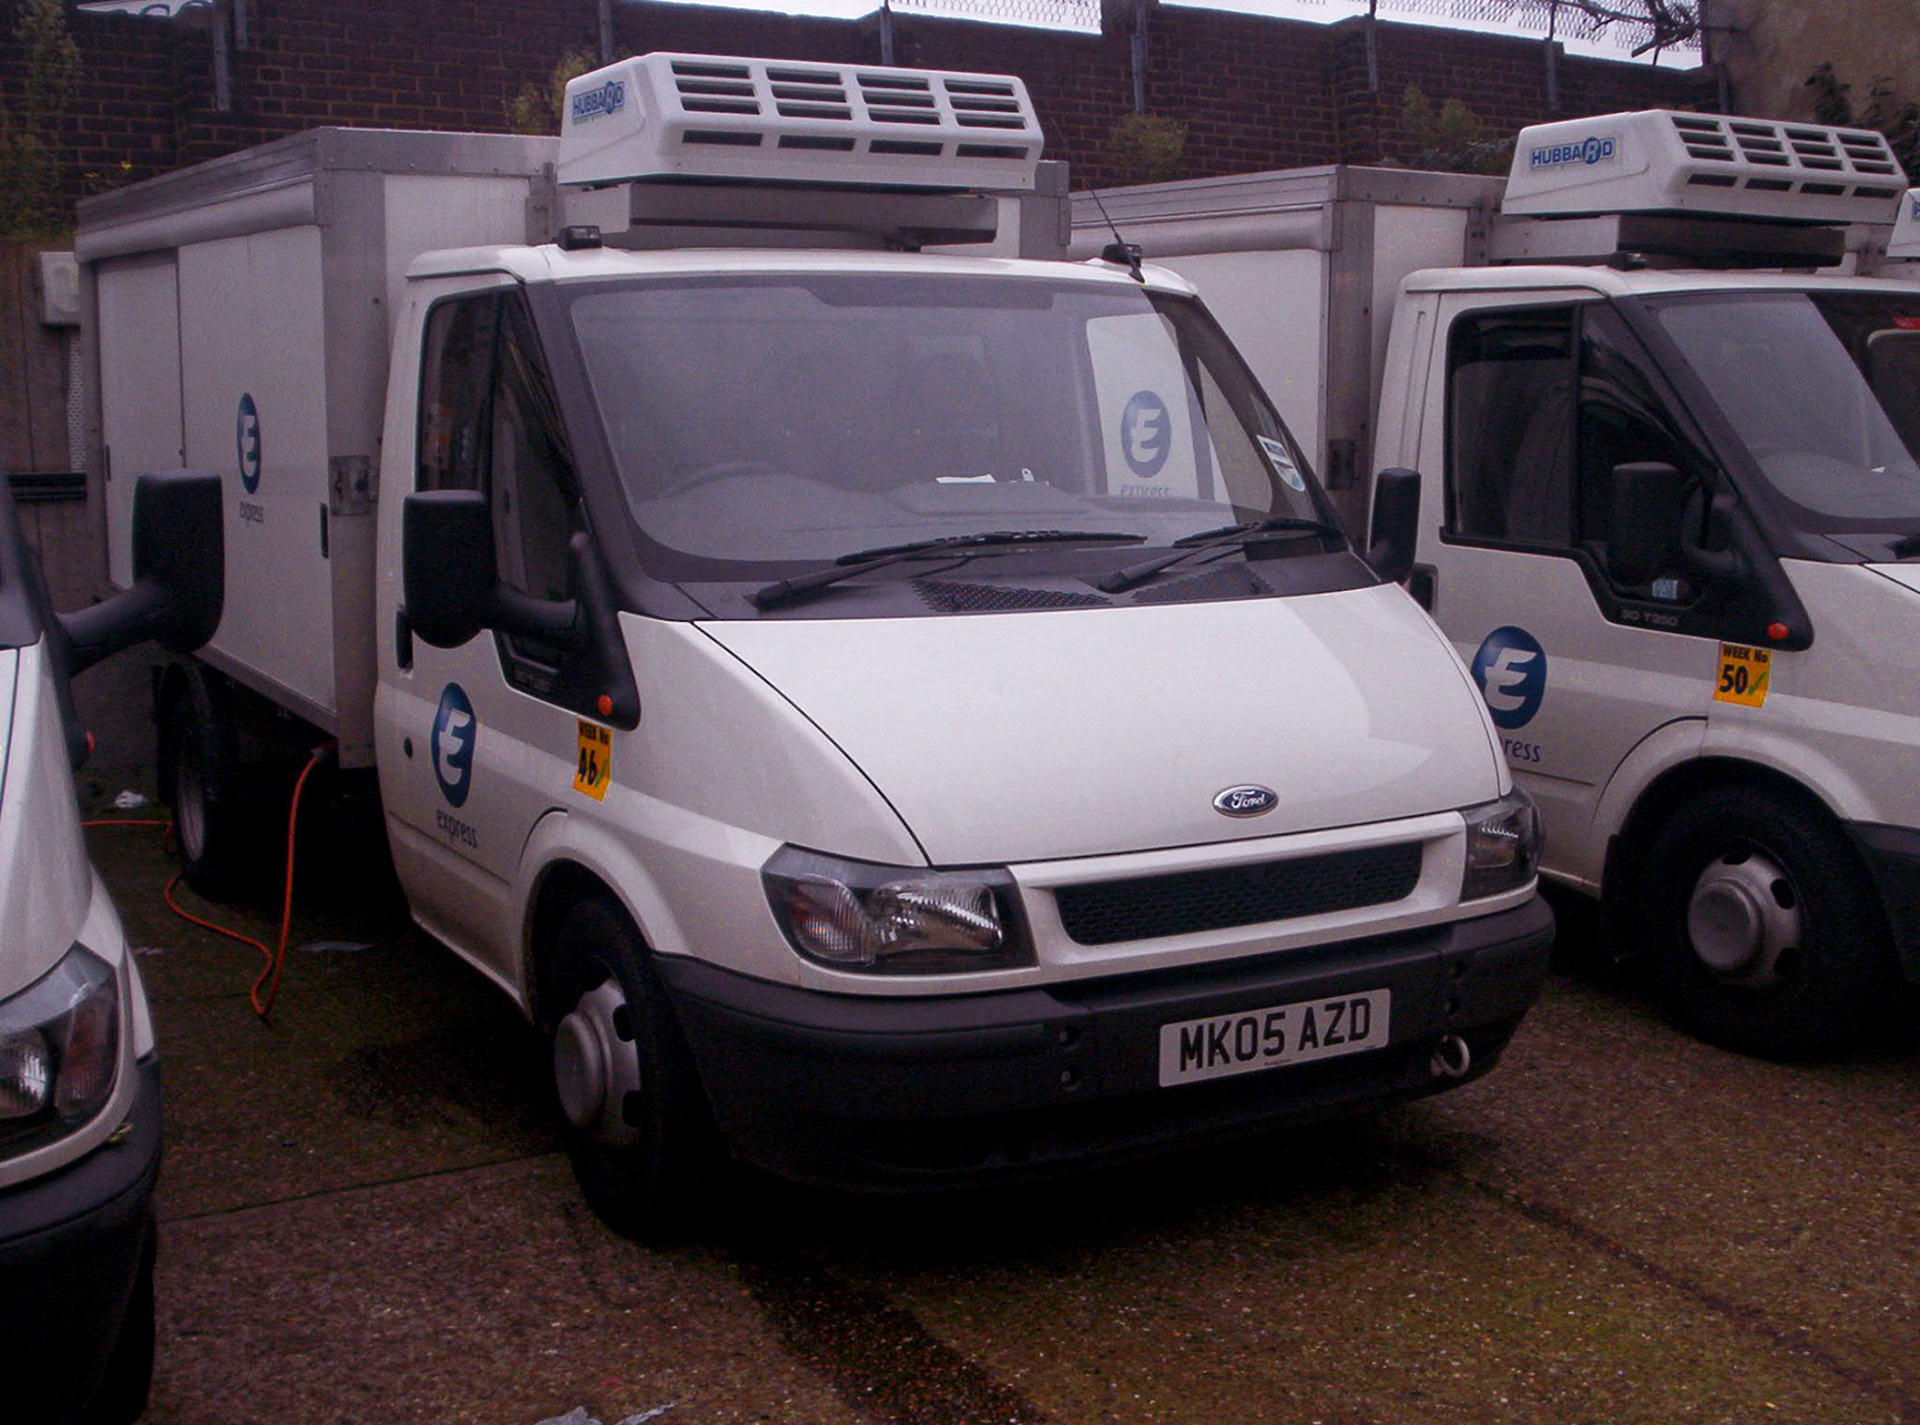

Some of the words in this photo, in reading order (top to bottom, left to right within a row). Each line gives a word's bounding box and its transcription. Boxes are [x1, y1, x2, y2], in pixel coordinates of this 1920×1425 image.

[572, 81, 623, 114] HUBBARD
[1531, 137, 1614, 164] HUBBARD
[1722, 644, 1750, 661] WEEK
[1719, 664, 1748, 694] 50
[1500, 737, 1541, 763] ress
[1231, 790, 1266, 809] Ford
[436, 808, 478, 849] express
[1179, 1011, 1286, 1072] MK05
[1298, 998, 1371, 1051] AZD
